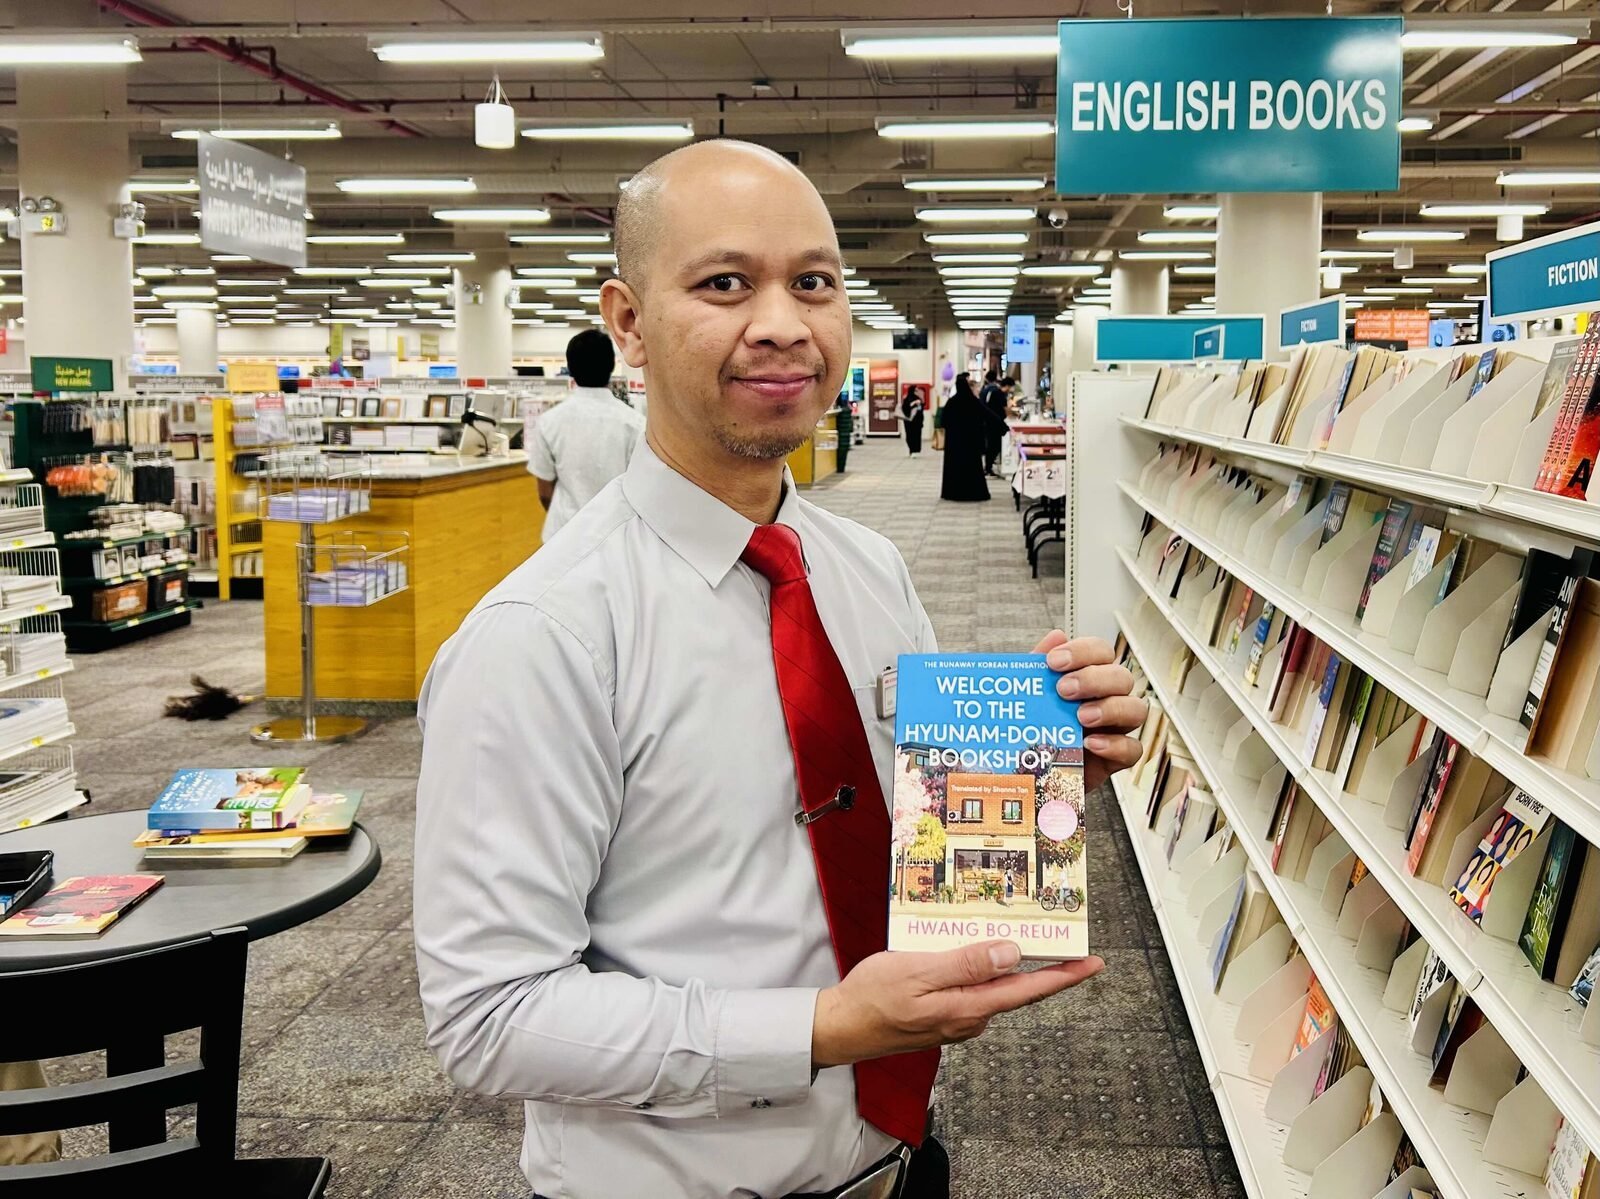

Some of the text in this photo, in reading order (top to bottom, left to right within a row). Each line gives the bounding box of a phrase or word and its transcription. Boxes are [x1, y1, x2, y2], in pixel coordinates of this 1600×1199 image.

[1072, 79, 1387, 132] ENGLISH BOOKS
[1548, 257, 1599, 287] FICTION
[1300, 319, 1317, 333] FICTION
[1572, 343, 1587, 378] COSBY
[1580, 343, 1596, 378] COSBY
[1560, 385, 1574, 414] KING
[1568, 385, 1582, 415] KING
[1577, 385, 1591, 415] KING
[1543, 426, 1561, 463] ASHES
[1551, 427, 1568, 465] ASHES
[1560, 428, 1577, 466] ASHES
[924, 661, 1049, 669] THE RUNAWAY KOREAN SENSATIO
[936, 676, 1043, 696] WELCOME
[953, 700, 1026, 720] TO THE
[905, 723, 1076, 745] HYUNAM-DONG
[929, 748, 1052, 770] BOOKSHOP
[951, 784, 1029, 794] Translated by Shanna Tan
[1515, 791, 1533, 808] BORN
[908, 920, 1070, 940] HWANG BO-REUM
